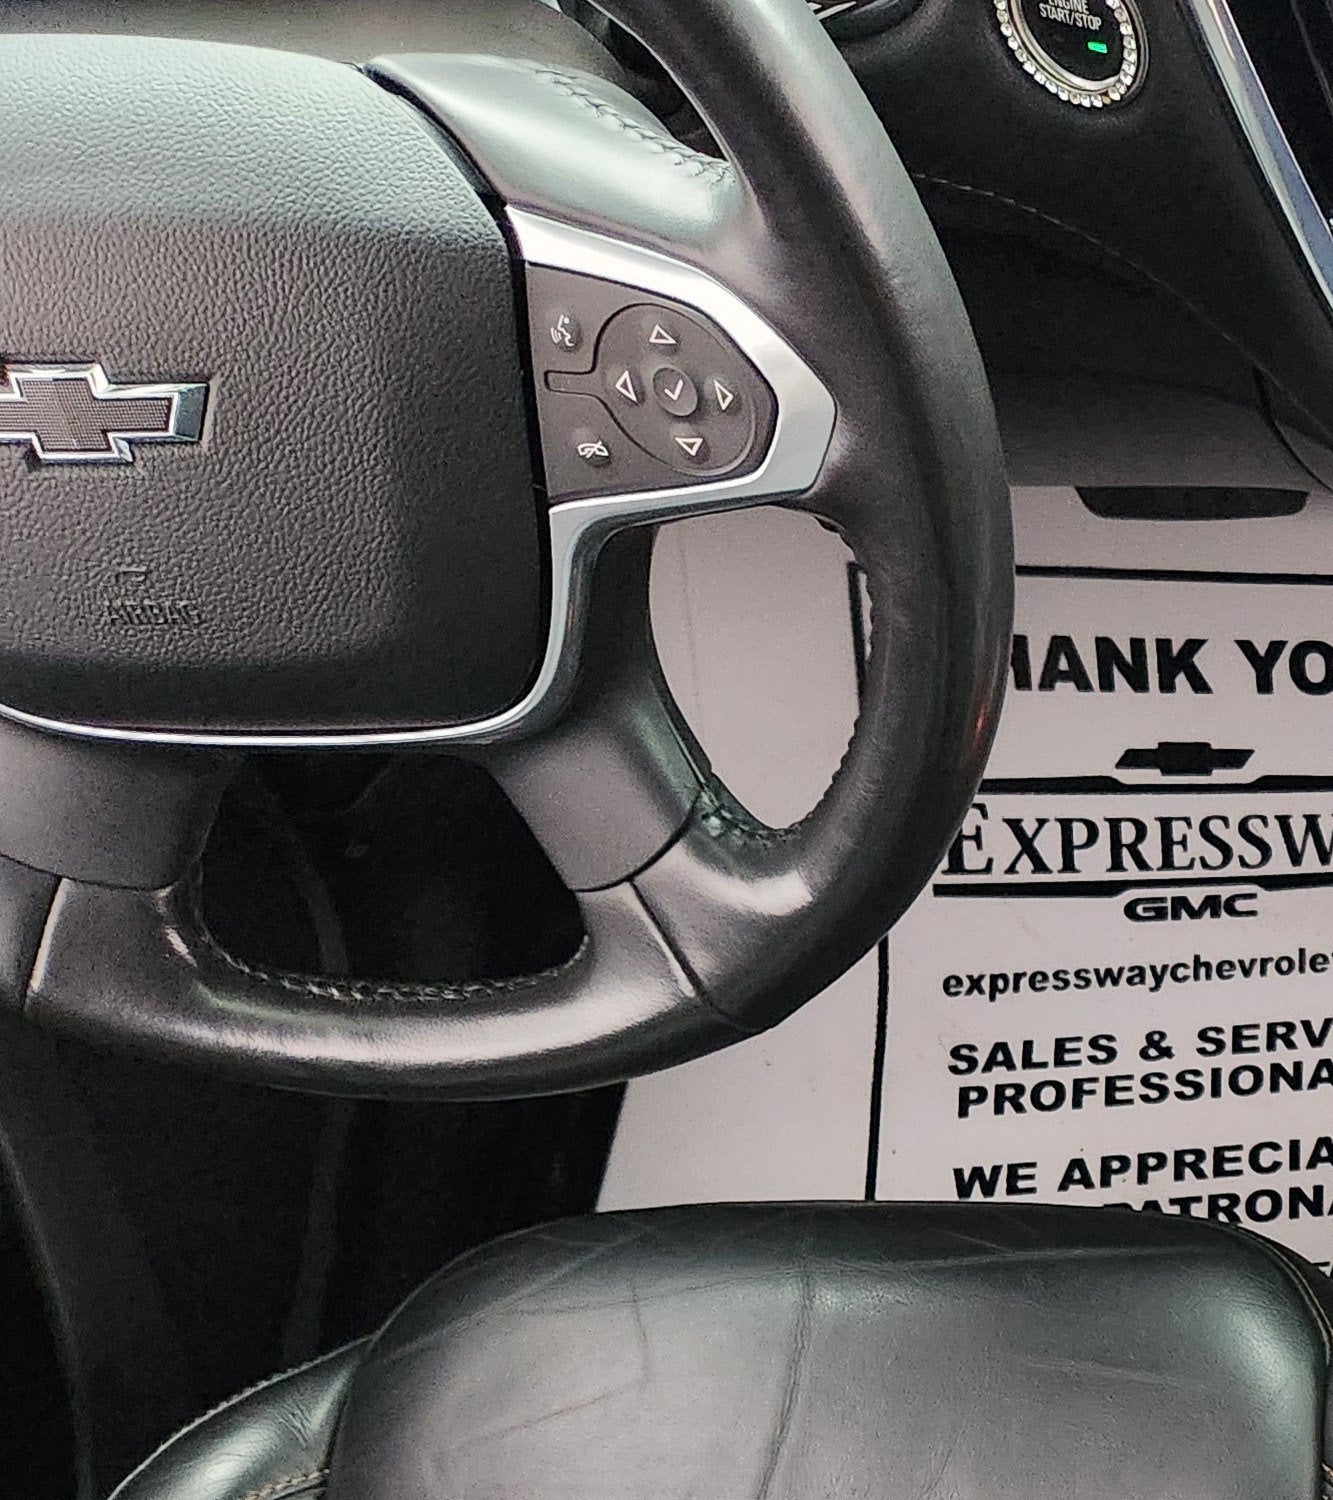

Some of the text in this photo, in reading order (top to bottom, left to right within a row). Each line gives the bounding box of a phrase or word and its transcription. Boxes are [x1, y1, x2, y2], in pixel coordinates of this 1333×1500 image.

[1039, 3, 1102, 31] START/STOP
[1011, 634, 1214, 694] ANK
[1124, 893, 1259, 922] GMC
[948, 1034, 1118, 1075] SALES
[1139, 1030, 1175, 1061] &
[953, 1162, 1038, 1199] WE
